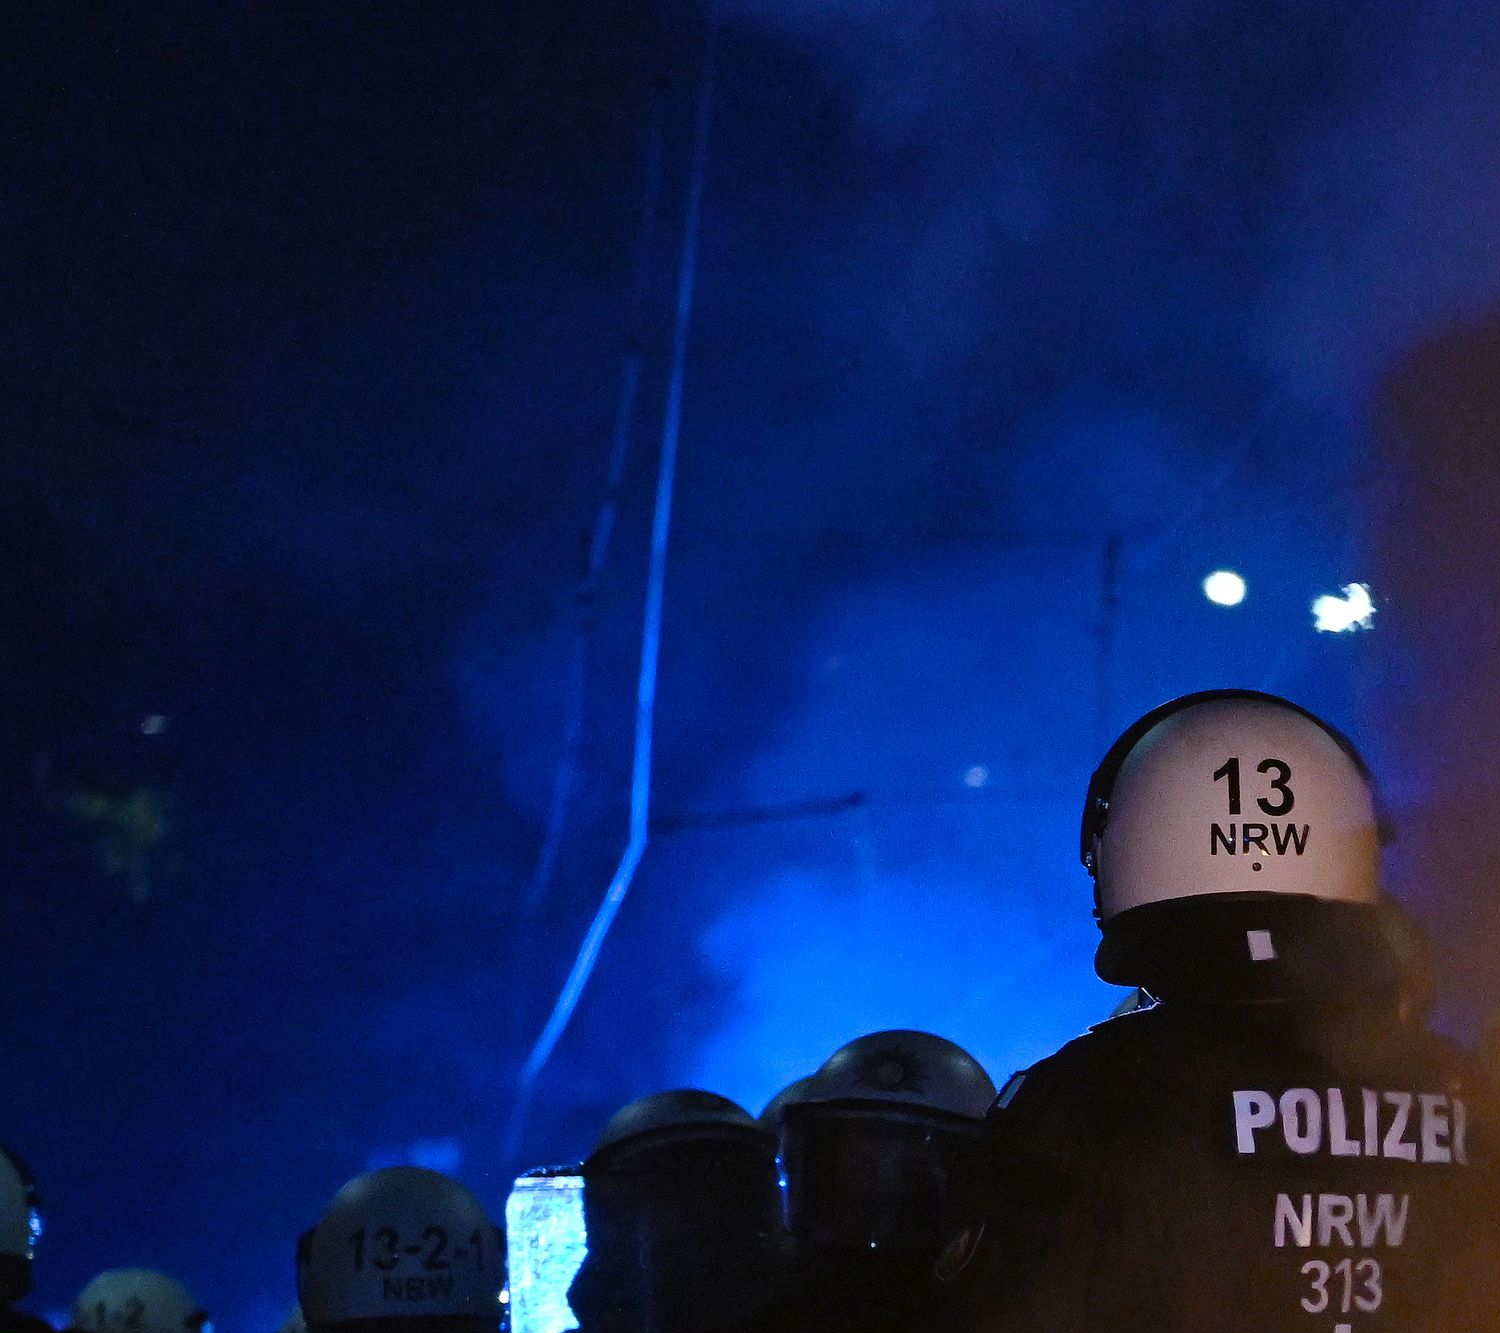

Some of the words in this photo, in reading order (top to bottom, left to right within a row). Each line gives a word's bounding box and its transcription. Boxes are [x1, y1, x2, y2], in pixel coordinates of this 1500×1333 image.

[1213, 757, 1295, 817] 13
[1210, 822, 1310, 857] NRW
[1233, 1087, 1468, 1166] POLIZEI
[1274, 1193, 1409, 1248] NRW
[346, 1224, 485, 1275] 13-2-1
[1300, 1258, 1383, 1313] 313
